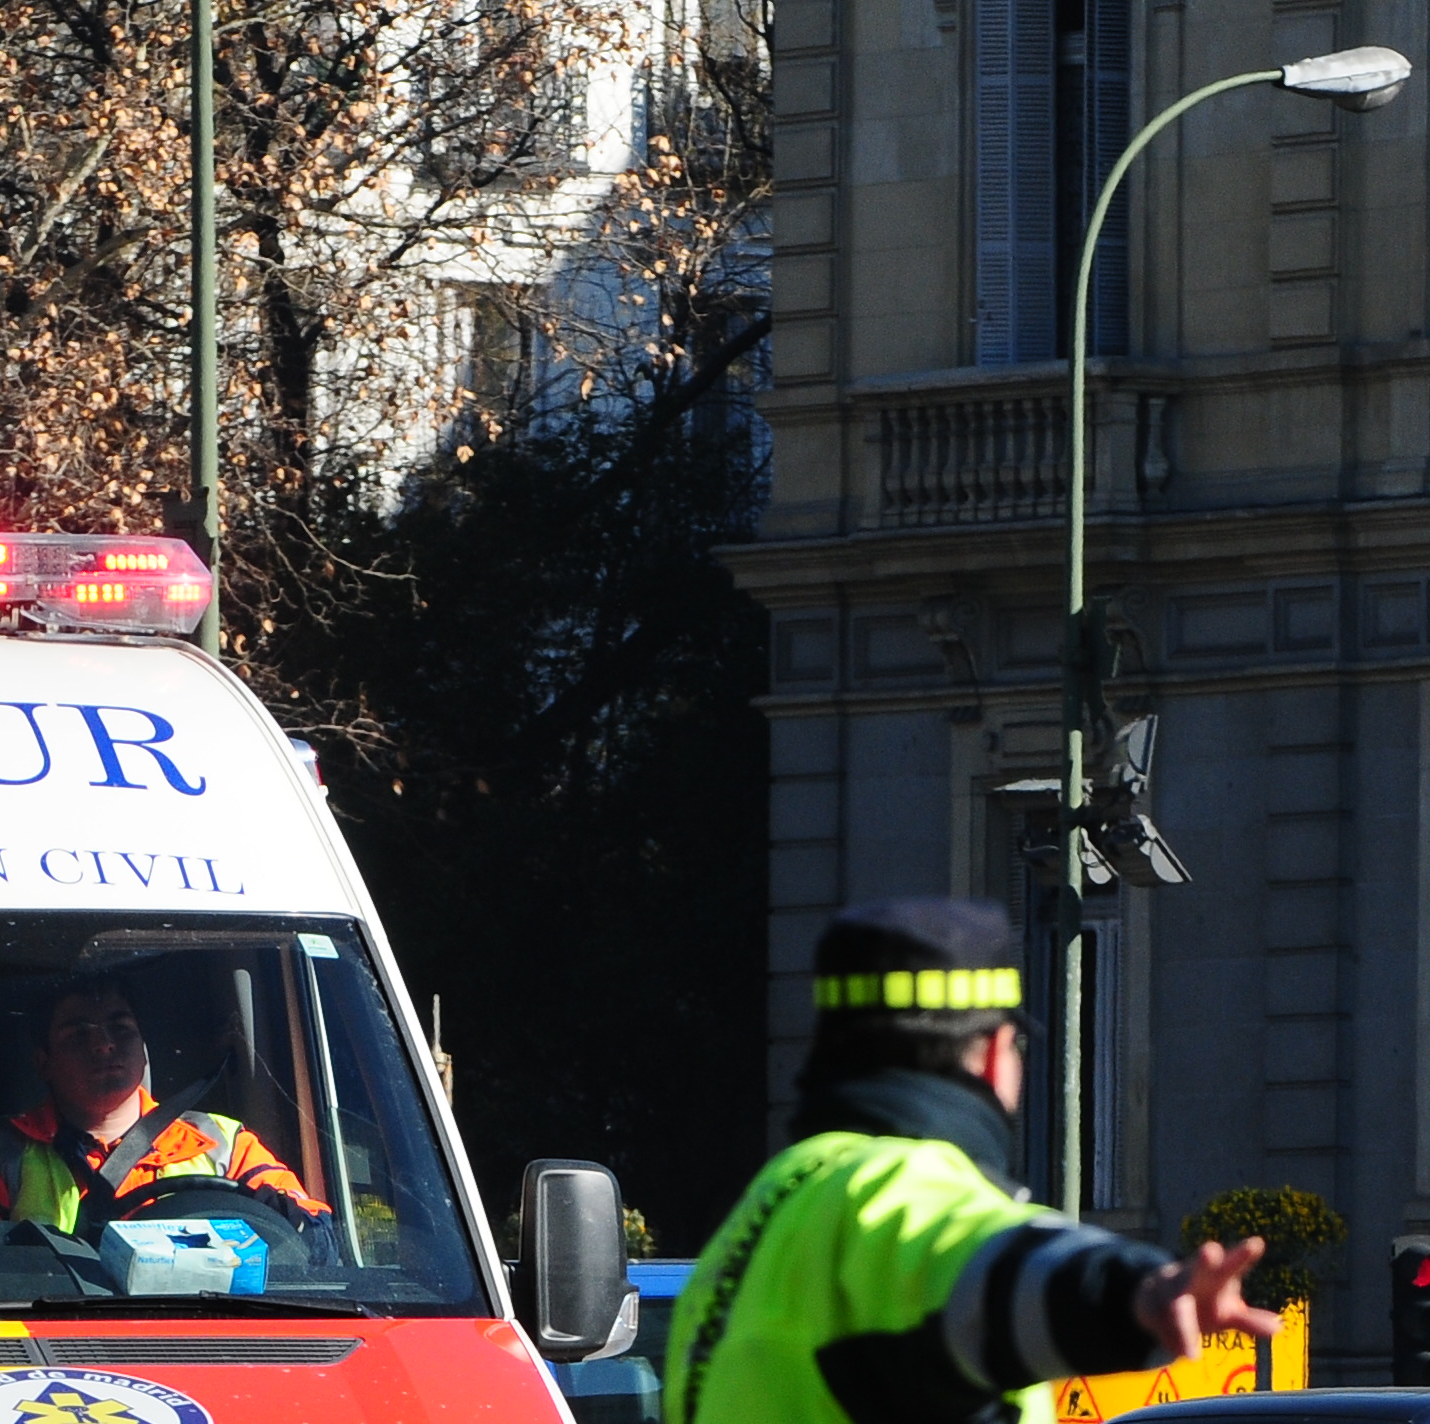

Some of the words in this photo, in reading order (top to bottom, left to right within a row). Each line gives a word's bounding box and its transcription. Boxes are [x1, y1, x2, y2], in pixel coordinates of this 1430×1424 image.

[40, 848, 246, 896] CIVIL
[27, 1369, 67, 1380] de
[83, 1371, 193, 1408] madrid
